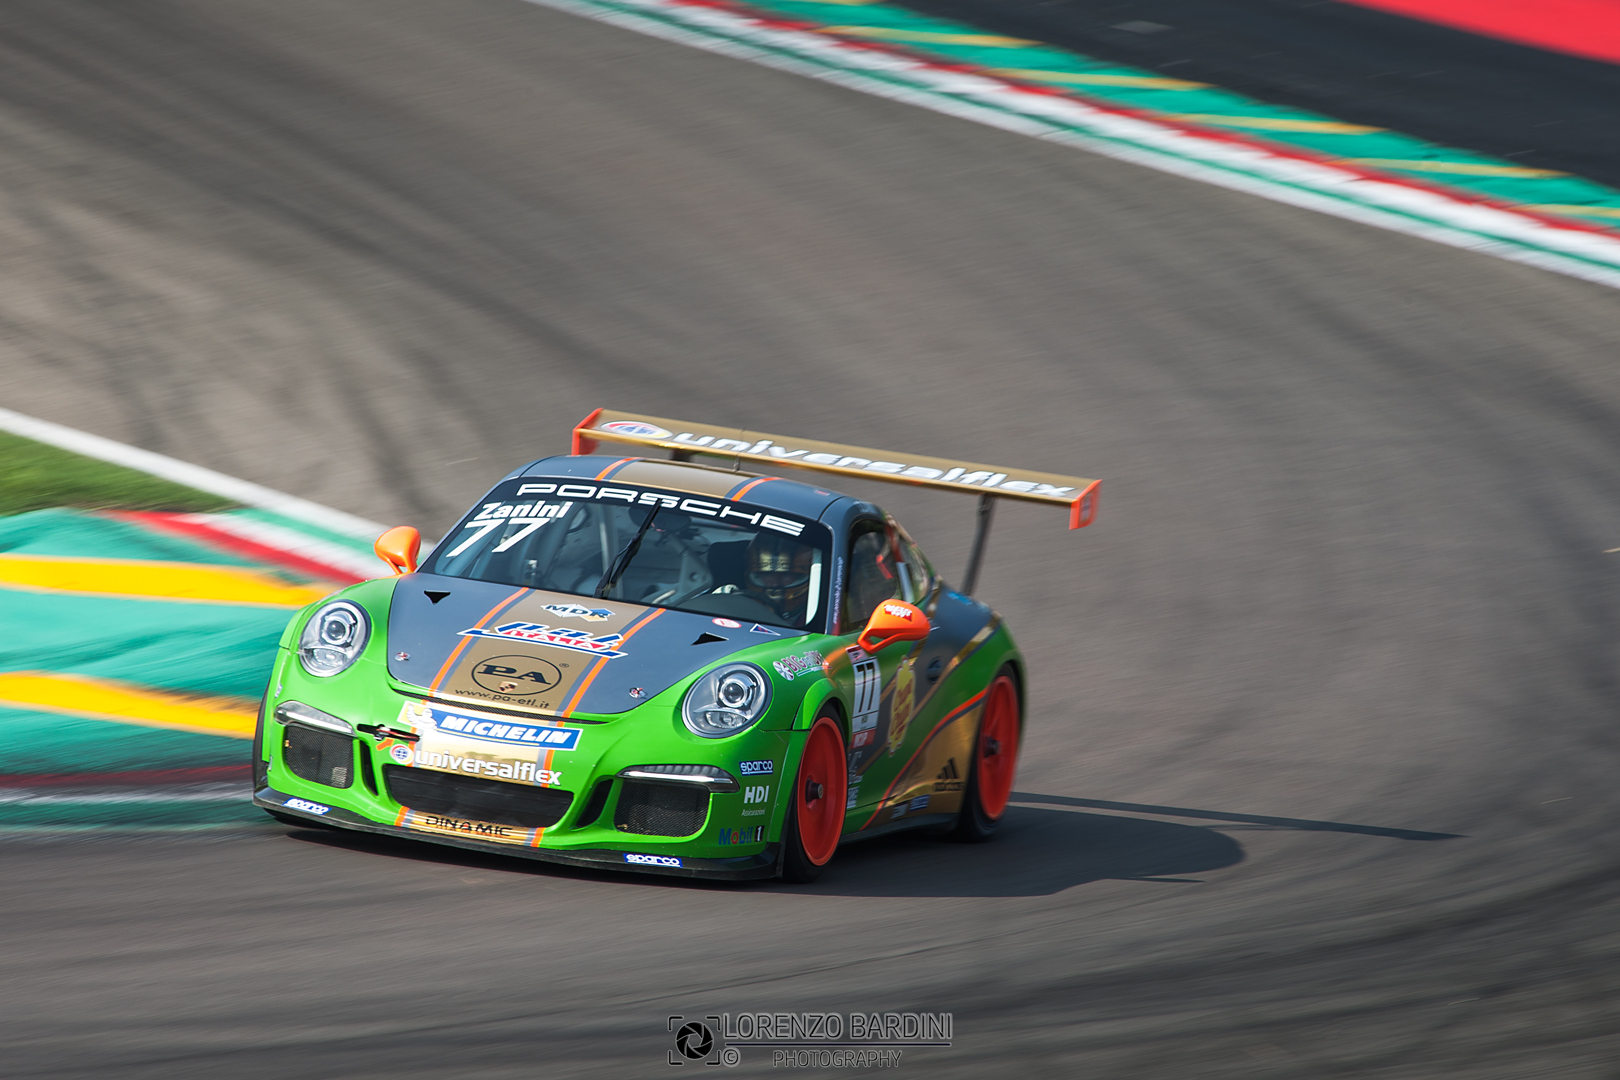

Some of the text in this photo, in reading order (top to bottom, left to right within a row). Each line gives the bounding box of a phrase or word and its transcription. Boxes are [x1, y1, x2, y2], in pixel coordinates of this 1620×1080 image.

[673, 432, 1074, 498] universalflex
[477, 501, 573, 520] Zanini
[516, 483, 806, 537] PORSCHE
[446, 518, 551, 559] 77
[509, 630, 595, 649] ITALIA
[477, 664, 552, 685] PA
[856, 662, 875, 713] 77
[455, 688, 550, 709] www.pa-etl.it
[439, 715, 573, 744] MICHELIN
[413, 750, 563, 786] universalflex
[740, 760, 773, 774] sparco
[743, 785, 770, 804] HDI
[285, 798, 330, 813] sparco
[719, 826, 754, 845] Mobil
[625, 853, 681, 866] sparco
